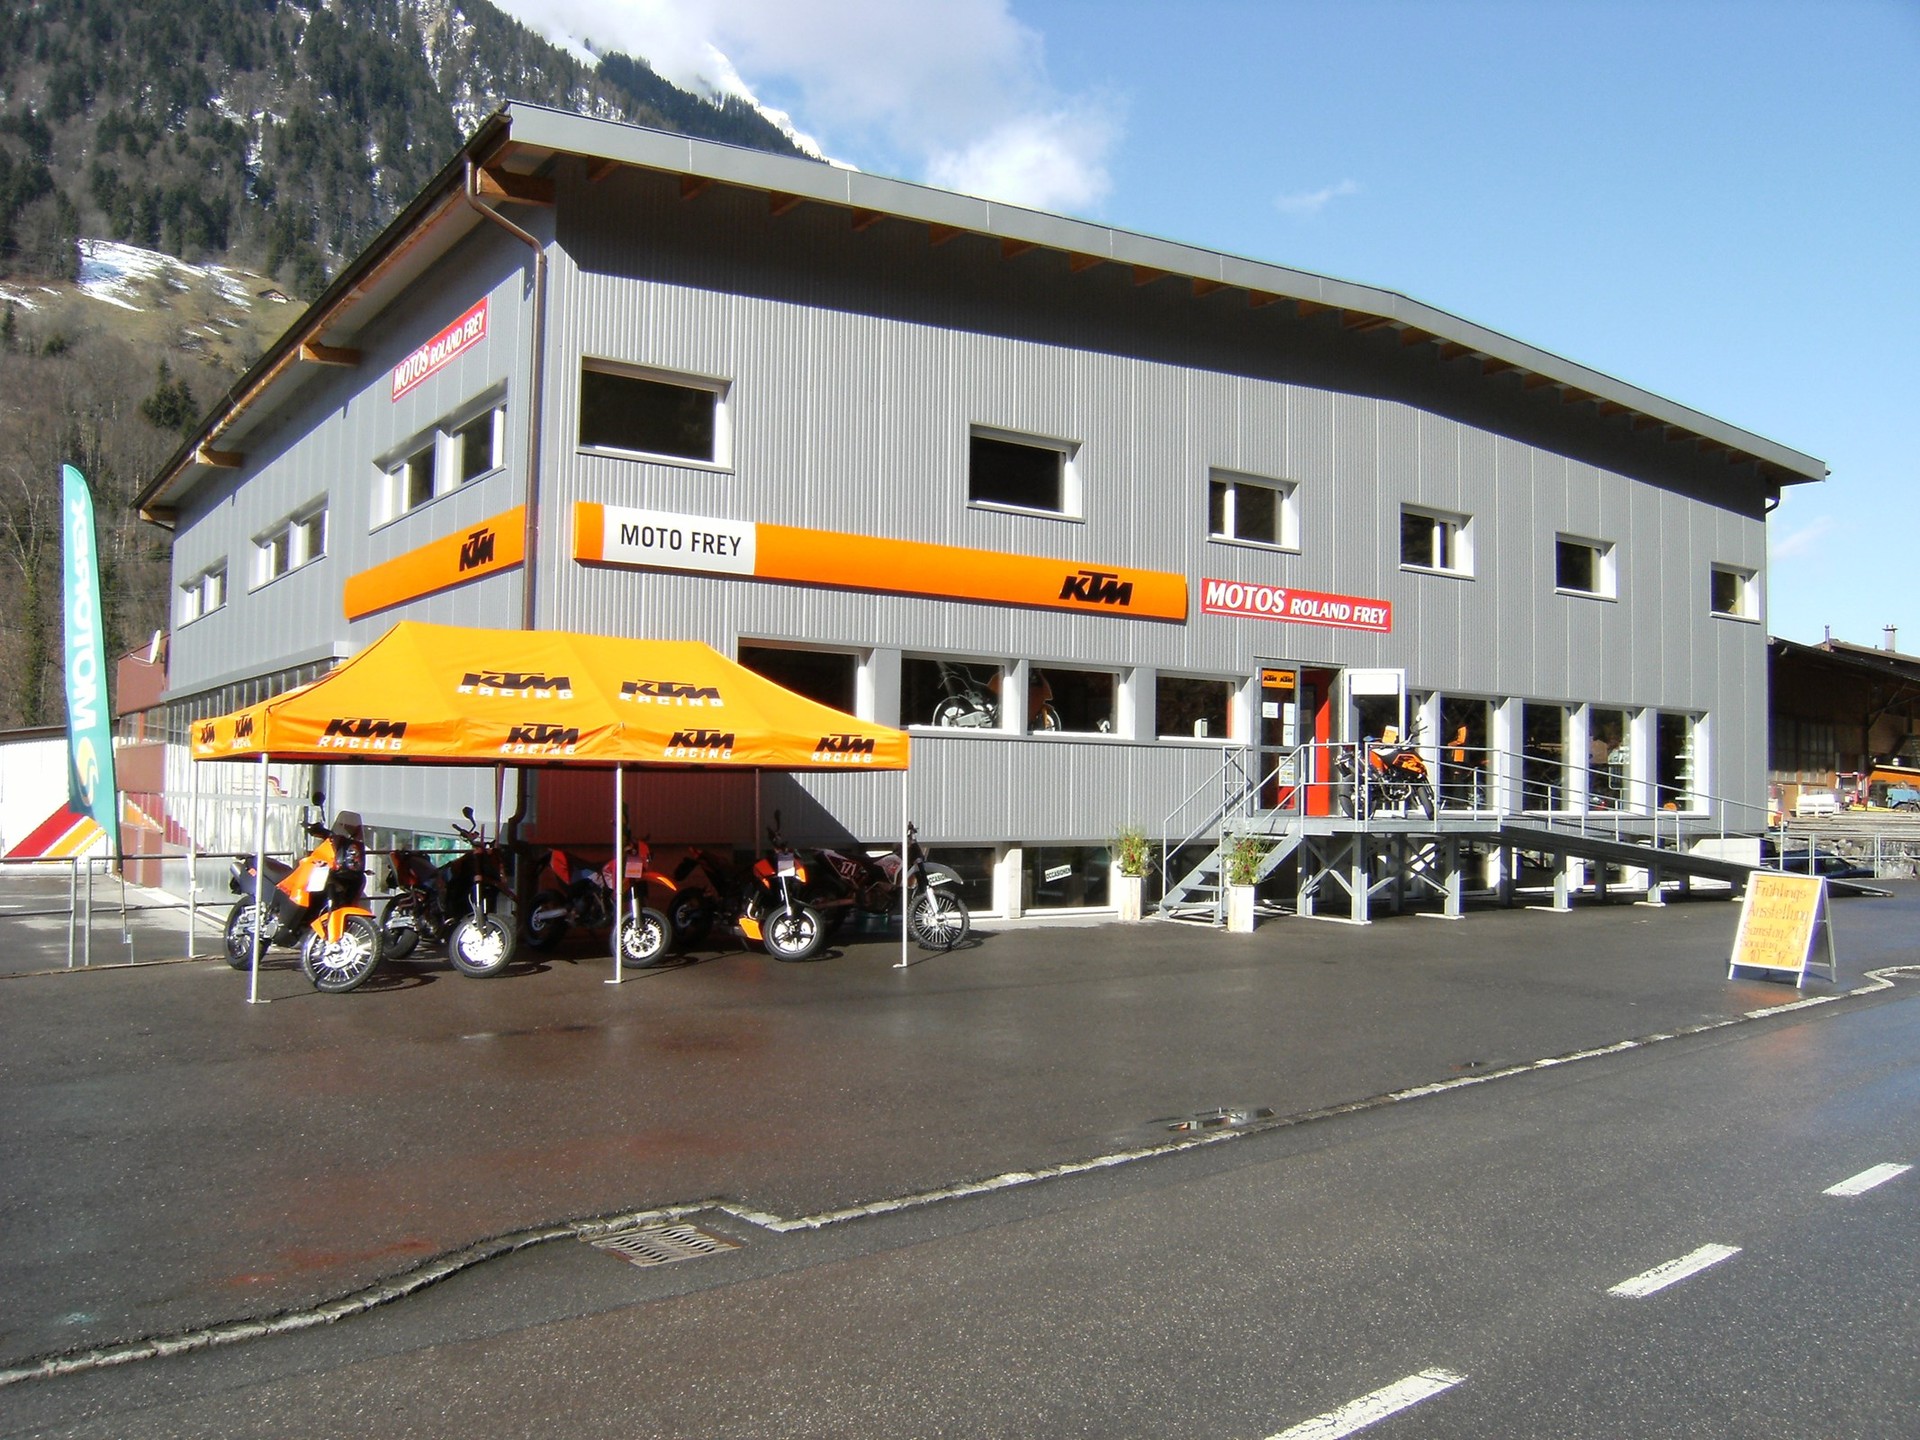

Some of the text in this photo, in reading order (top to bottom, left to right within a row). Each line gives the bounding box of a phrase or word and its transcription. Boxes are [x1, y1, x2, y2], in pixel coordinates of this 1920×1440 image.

[393, 308, 486, 393] MOTOS ROLAND FREY
[459, 528, 495, 572] KTM
[620, 523, 742, 557] MOTO FREY
[1058, 570, 1133, 606] KTM
[1206, 581, 1388, 625] MOTOS ROLAND FREY
[461, 670, 571, 690] KTM
[620, 679, 721, 699] KTM
[457, 685, 573, 700] RACING
[234, 713, 253, 738] KTM
[324, 716, 407, 738] KTM
[506, 722, 579, 745] KTM
[317, 735, 404, 750] RACING
[668, 728, 735, 749] KTM
[814, 733, 875, 754] KTM
[499, 743, 577, 756] RACING
[663, 747, 733, 760] RACING
[810, 751, 872, 764] RACING
[840, 861, 857, 876] 171
